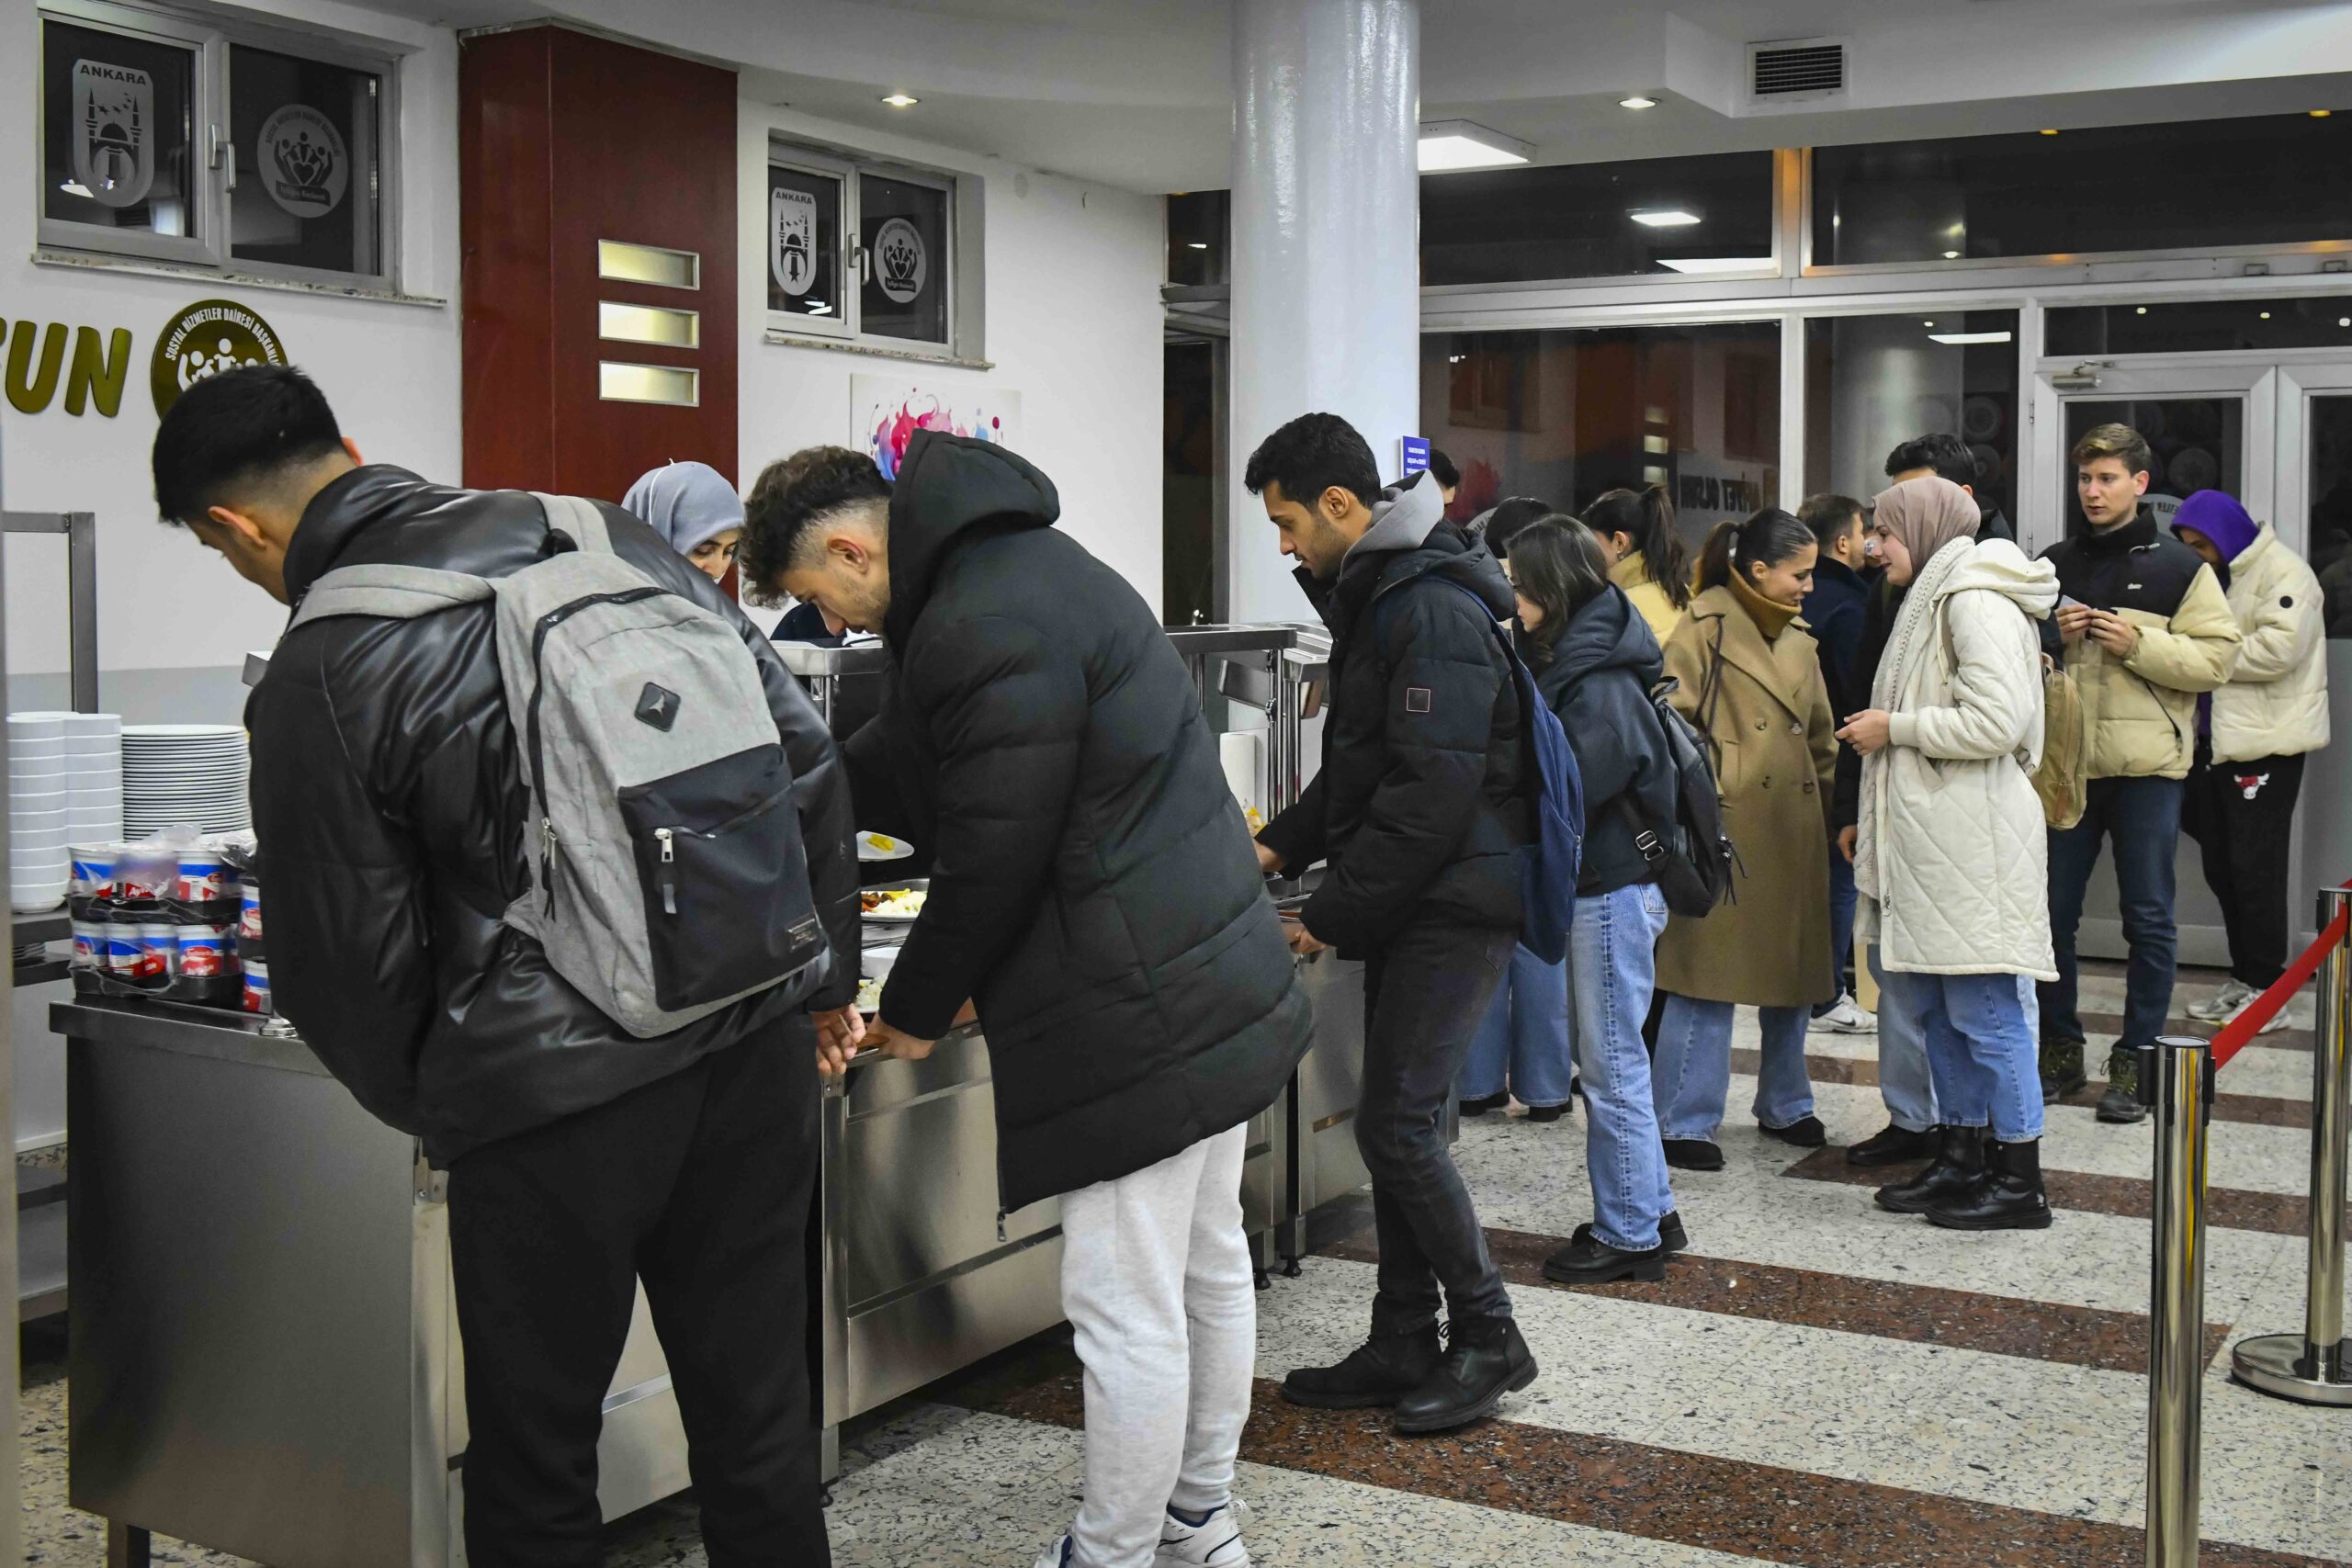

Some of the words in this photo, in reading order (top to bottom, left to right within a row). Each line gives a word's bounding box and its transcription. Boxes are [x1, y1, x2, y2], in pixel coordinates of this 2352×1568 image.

[80, 64, 147, 85] ANKARA
[775, 191, 812, 205] ANKARA
[165, 327, 187, 361] SOSYAL
[181, 307, 222, 333] HİZMETLER
[223, 308, 254, 331] DAİRESİ
[0, 317, 133, 419] UN
